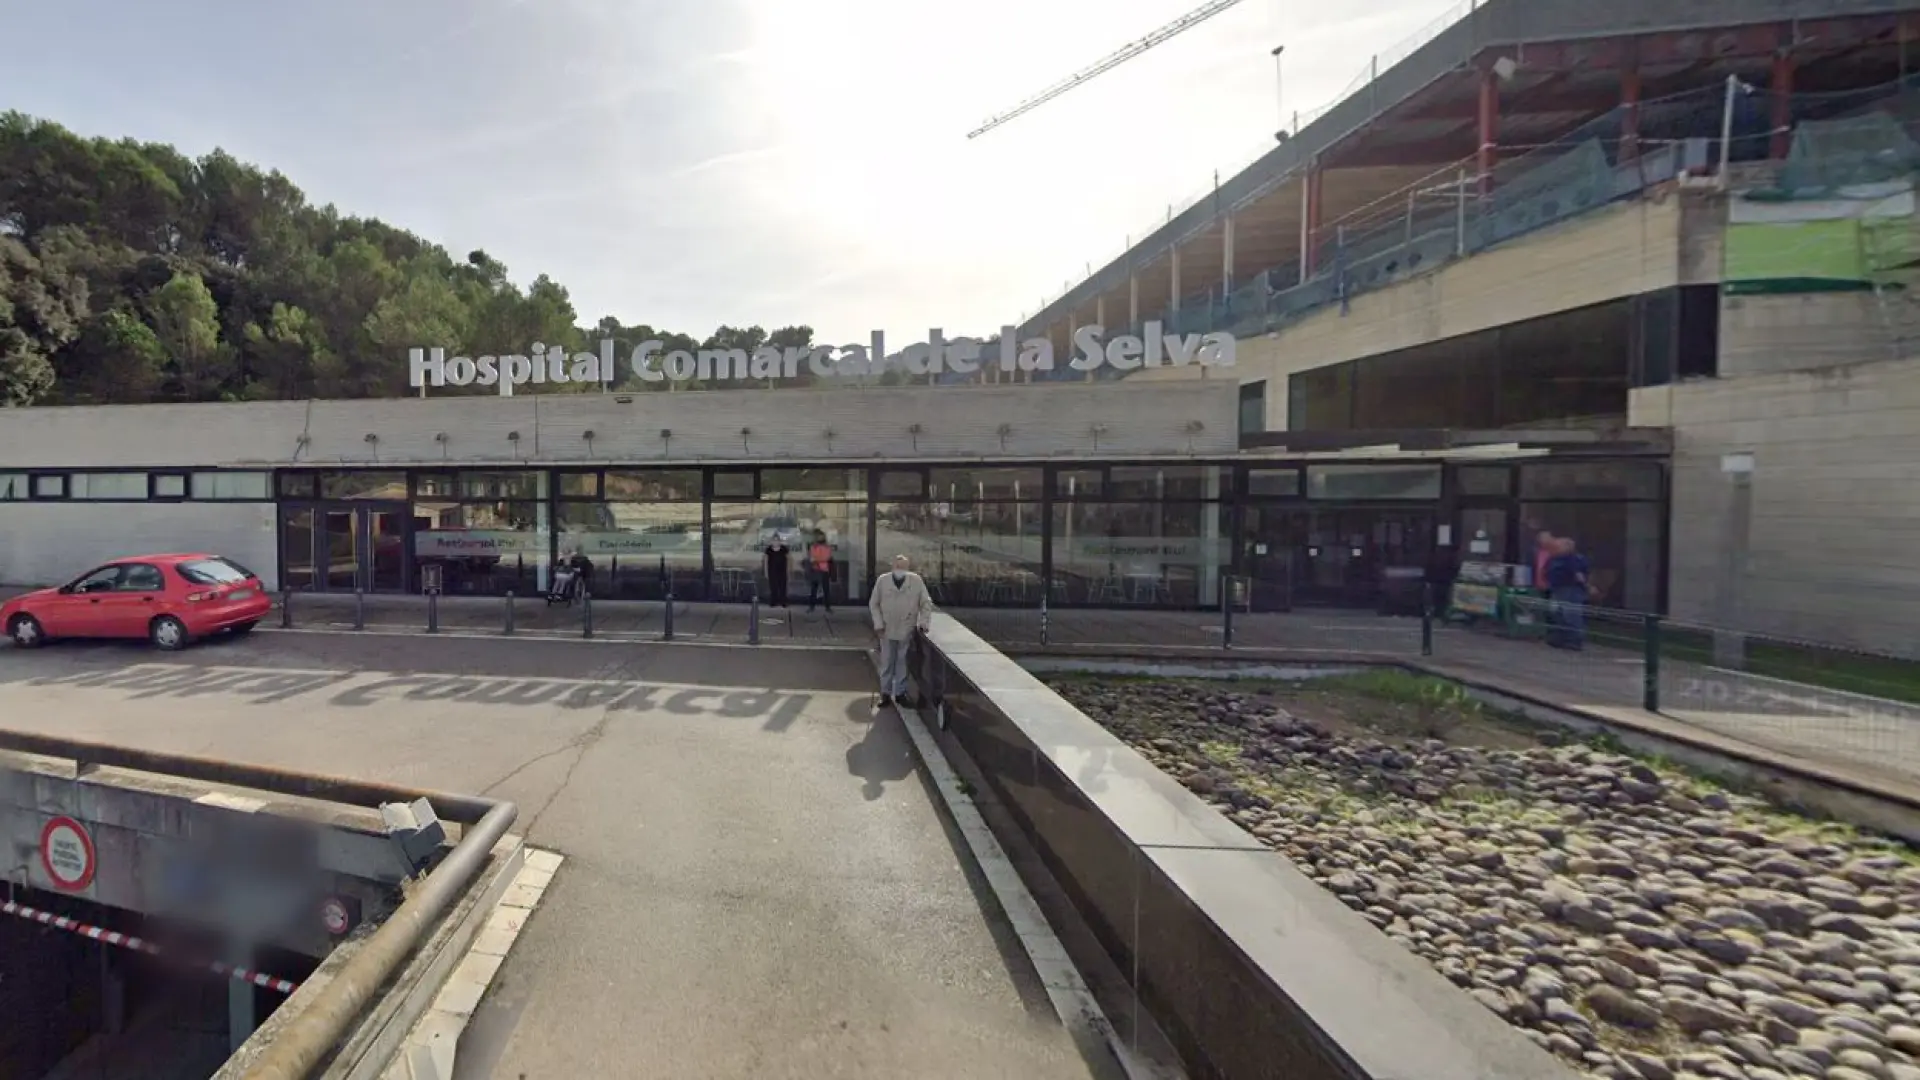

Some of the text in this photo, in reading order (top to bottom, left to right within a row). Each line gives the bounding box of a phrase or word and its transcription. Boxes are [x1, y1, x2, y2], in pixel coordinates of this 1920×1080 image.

[409, 320, 1237, 396] Hospital Comarcal de la Selva
